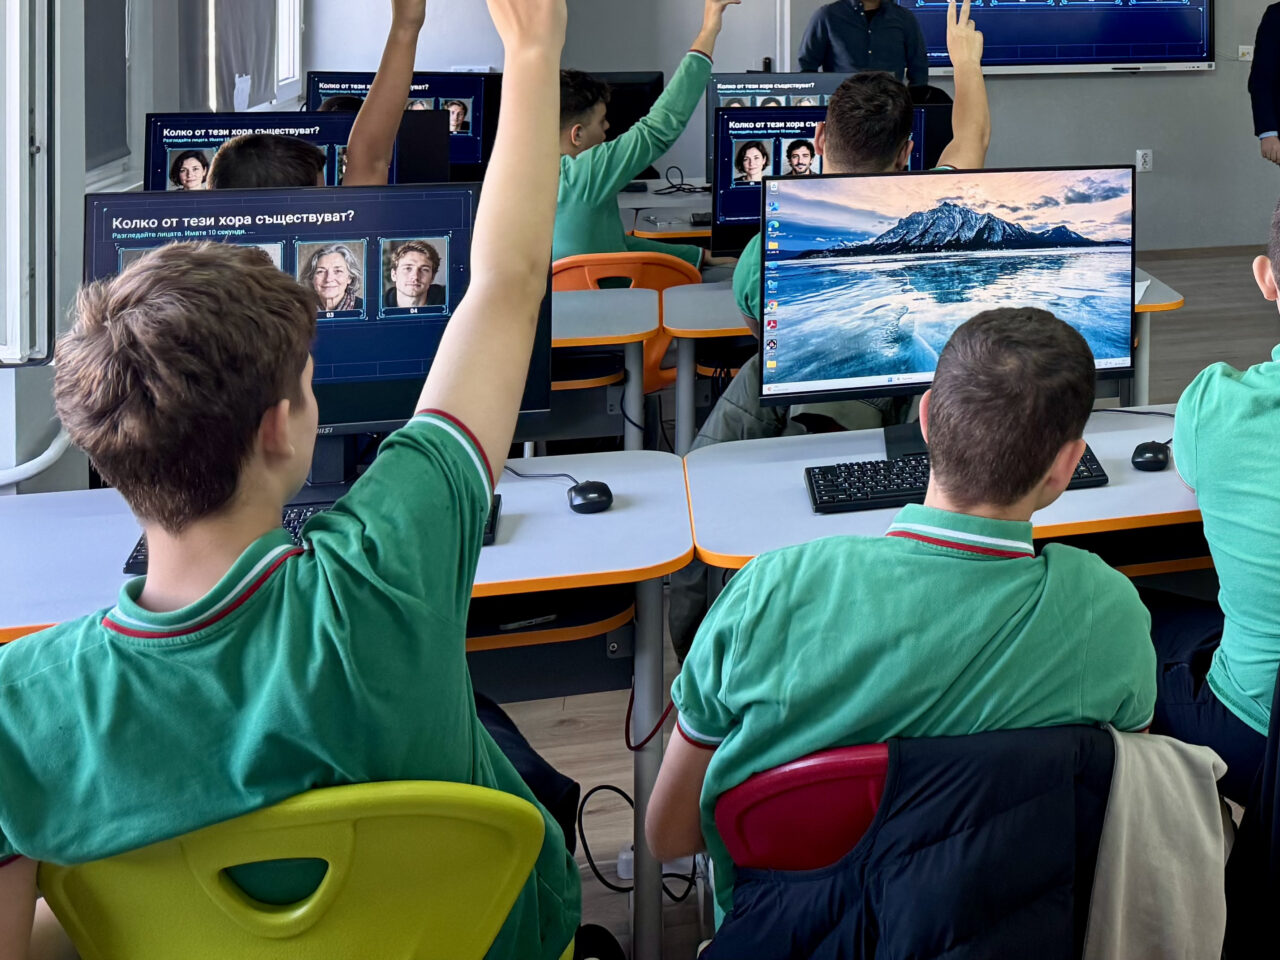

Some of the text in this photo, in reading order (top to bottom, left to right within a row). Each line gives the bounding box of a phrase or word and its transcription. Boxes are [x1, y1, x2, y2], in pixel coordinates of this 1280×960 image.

[729, 121, 754, 129] Колко
[786, 121, 804, 129] хора
[163, 128, 193, 137] Колко
[231, 129, 253, 137] хора
[112, 210, 355, 229] Колко от тези хора съществуват?
